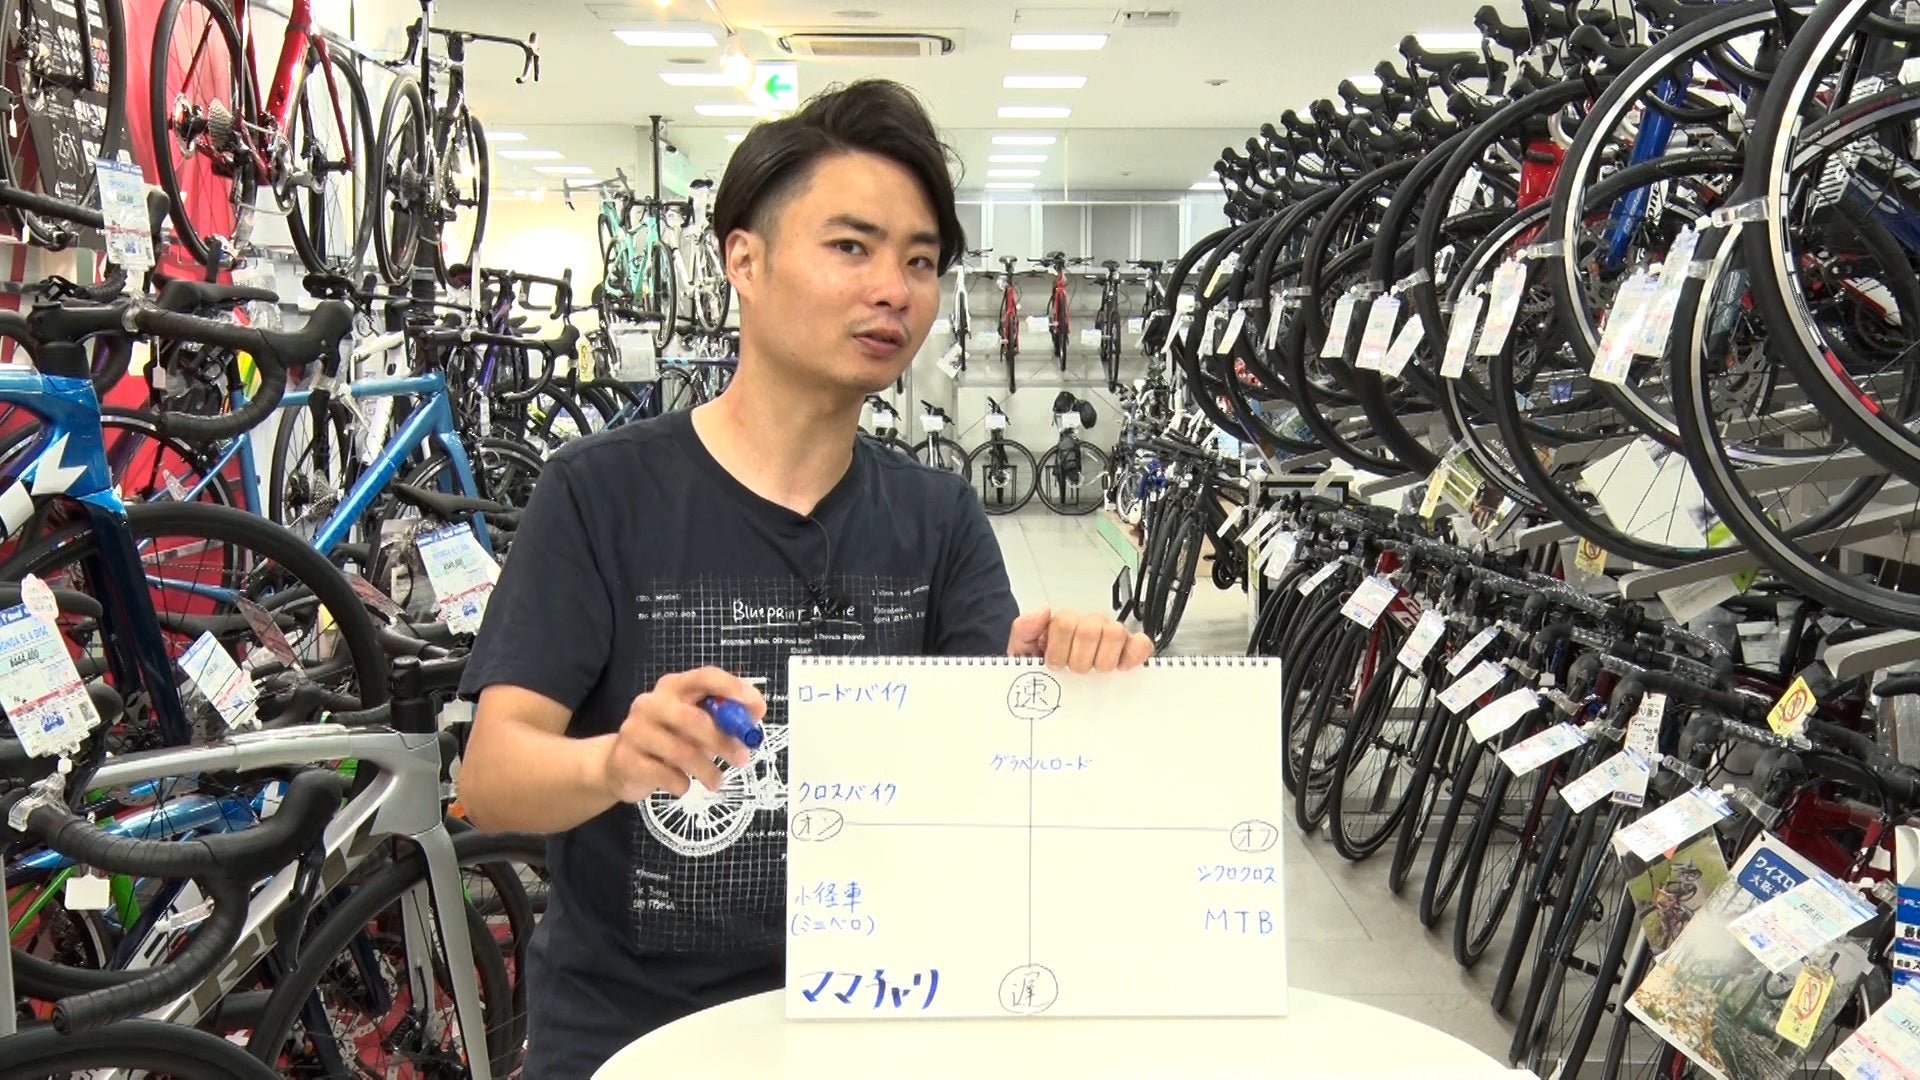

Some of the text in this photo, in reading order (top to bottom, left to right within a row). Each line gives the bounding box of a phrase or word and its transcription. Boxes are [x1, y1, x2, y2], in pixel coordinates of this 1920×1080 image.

[799, 682, 907, 710] ロードバイク
[1013, 676, 1058, 712] 速
[991, 754, 1093, 772] グラベルロード
[799, 782, 896, 806] クロスバイク
[798, 814, 843, 836] オン
[1237, 823, 1272, 848] オフ
[1198, 865, 1277, 884] シクロクロス
[794, 882, 862, 913] 小径車
[791, 914, 874, 936] (ミニベロ)
[1205, 908, 1273, 934] MTB
[800, 969, 939, 1010] ママチャリ
[1012, 971, 1051, 1008] 遅
